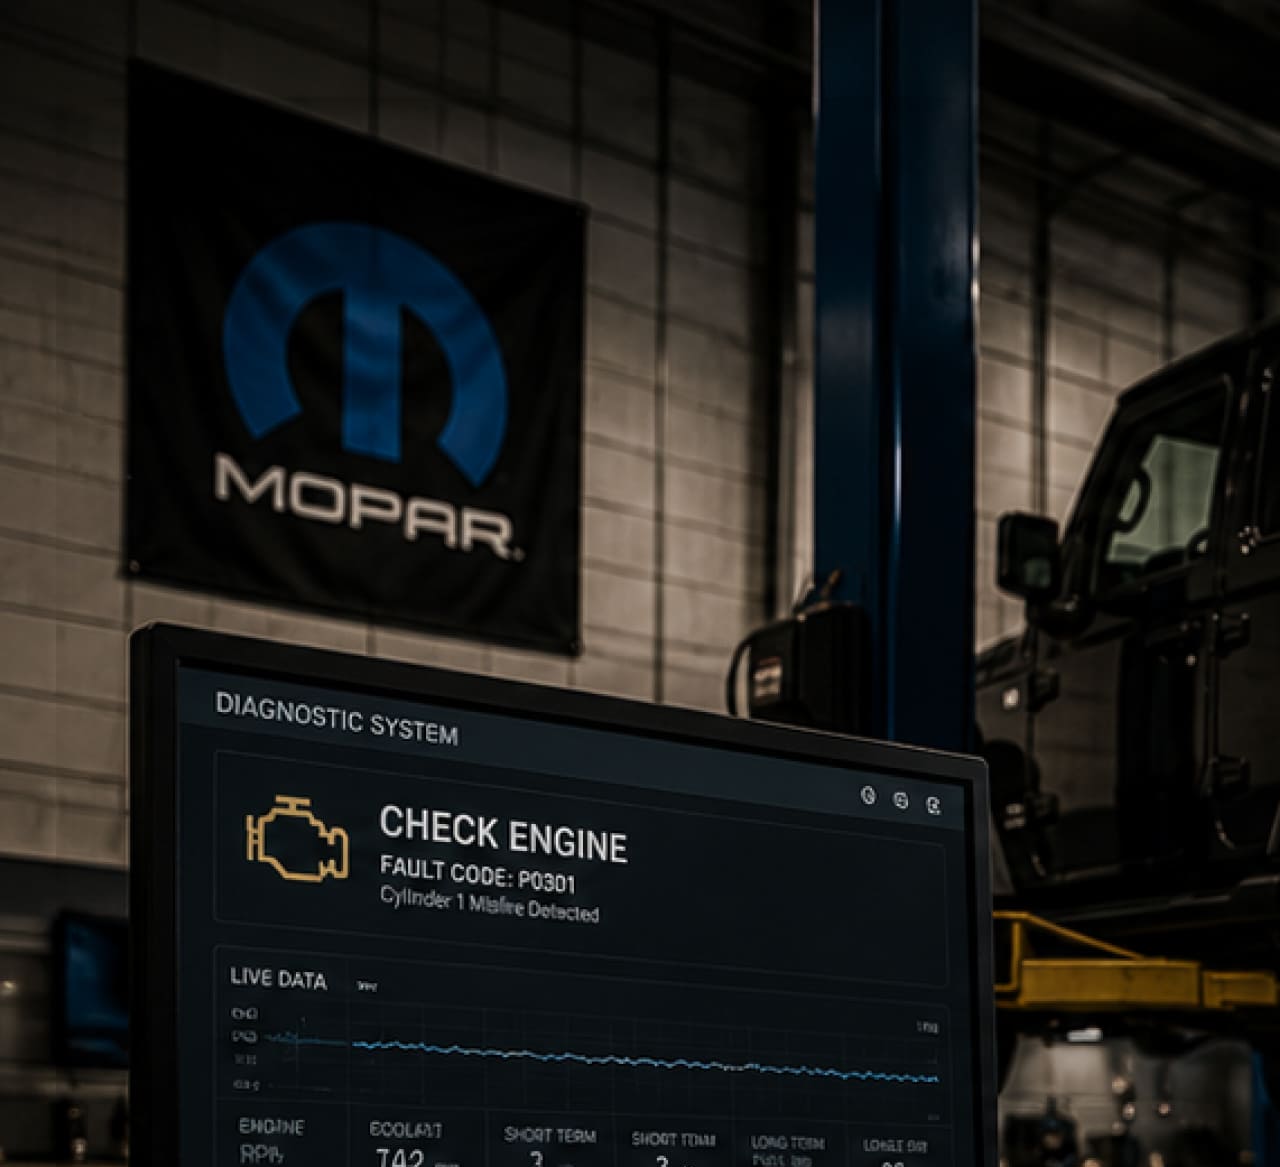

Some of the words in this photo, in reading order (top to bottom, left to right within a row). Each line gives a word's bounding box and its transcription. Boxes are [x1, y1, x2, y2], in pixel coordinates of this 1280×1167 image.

[215, 691, 364, 734] DIAGNOSTIC
[370, 715, 459, 746] SYSTEM
[379, 804, 499, 849] CHECK
[509, 821, 629, 863] ENGINE
[380, 855, 445, 881] FAULT
[451, 864, 513, 889] CODE:
[518, 870, 576, 894] P0301
[380, 885, 451, 910] Cylinder
[456, 892, 465, 910] 1
[527, 901, 600, 924] Detected
[230, 966, 272, 987] LIVE
[277, 970, 328, 991] DATA
[503, 1125, 552, 1144] SHORT
[557, 1128, 597, 1145] TERM
